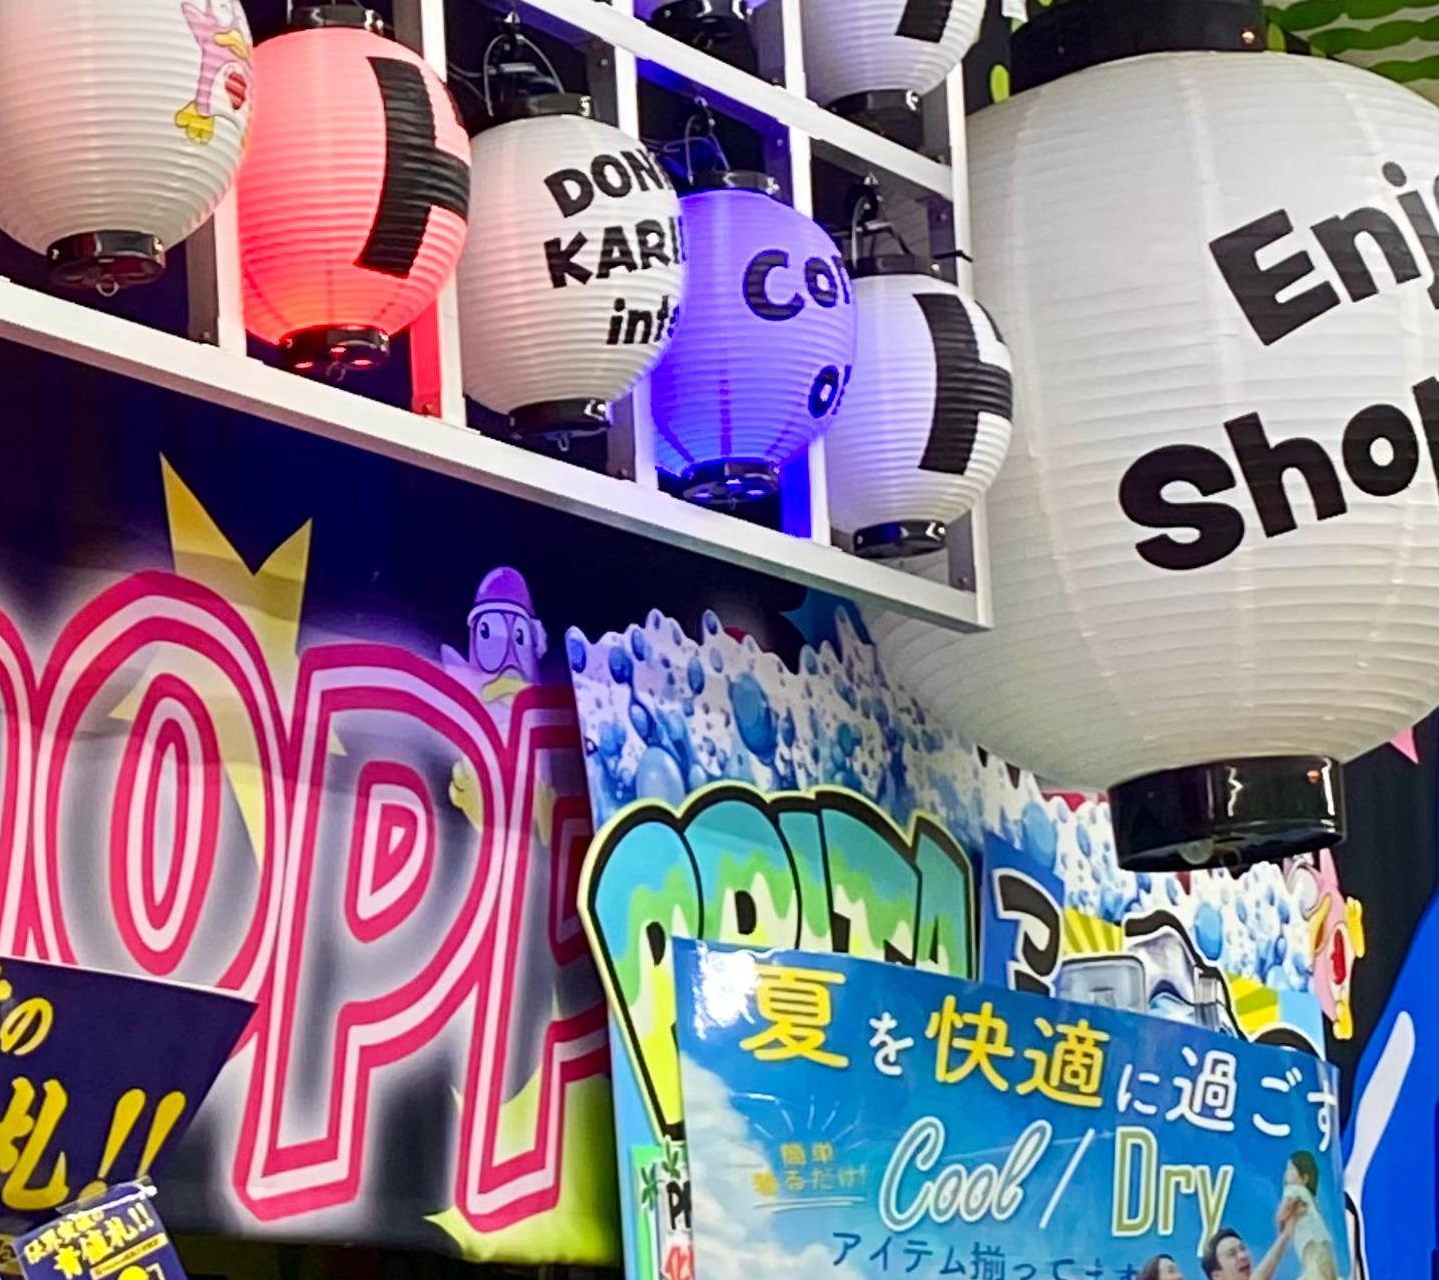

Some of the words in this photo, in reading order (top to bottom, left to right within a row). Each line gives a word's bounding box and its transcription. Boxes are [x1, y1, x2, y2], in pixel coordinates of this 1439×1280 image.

[1209, 161, 1439, 347] Enj
[1118, 376, 1439, 571] Sho
[739, 965, 1340, 1151] 夏を快適に過ごす
[878, 1116, 1053, 1233] Cool
[1112, 1126, 1234, 1256] Dry
